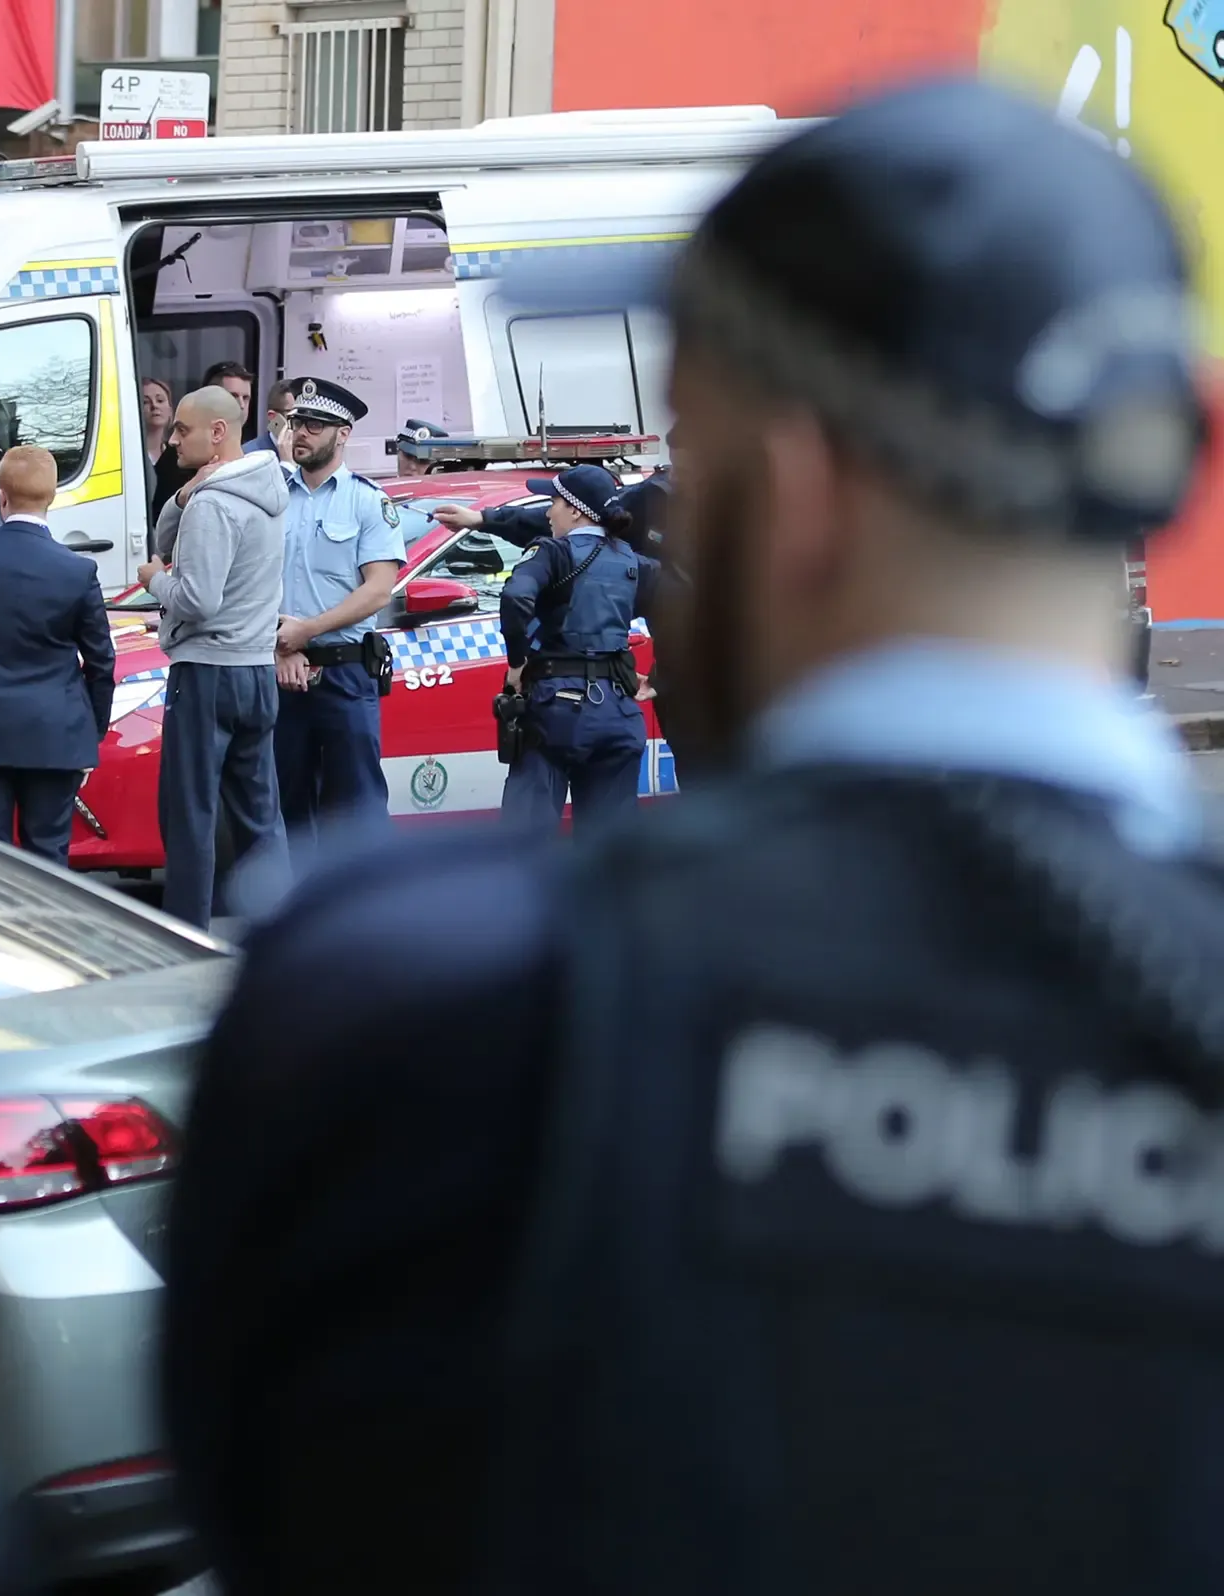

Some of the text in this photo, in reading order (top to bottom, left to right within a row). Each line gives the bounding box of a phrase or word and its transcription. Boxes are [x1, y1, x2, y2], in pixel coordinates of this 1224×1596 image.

[111, 75, 140, 92] 4P
[173, 125, 189, 137] NO
[403, 664, 454, 691] SC2
[716, 1022, 1224, 1255] POLIC
